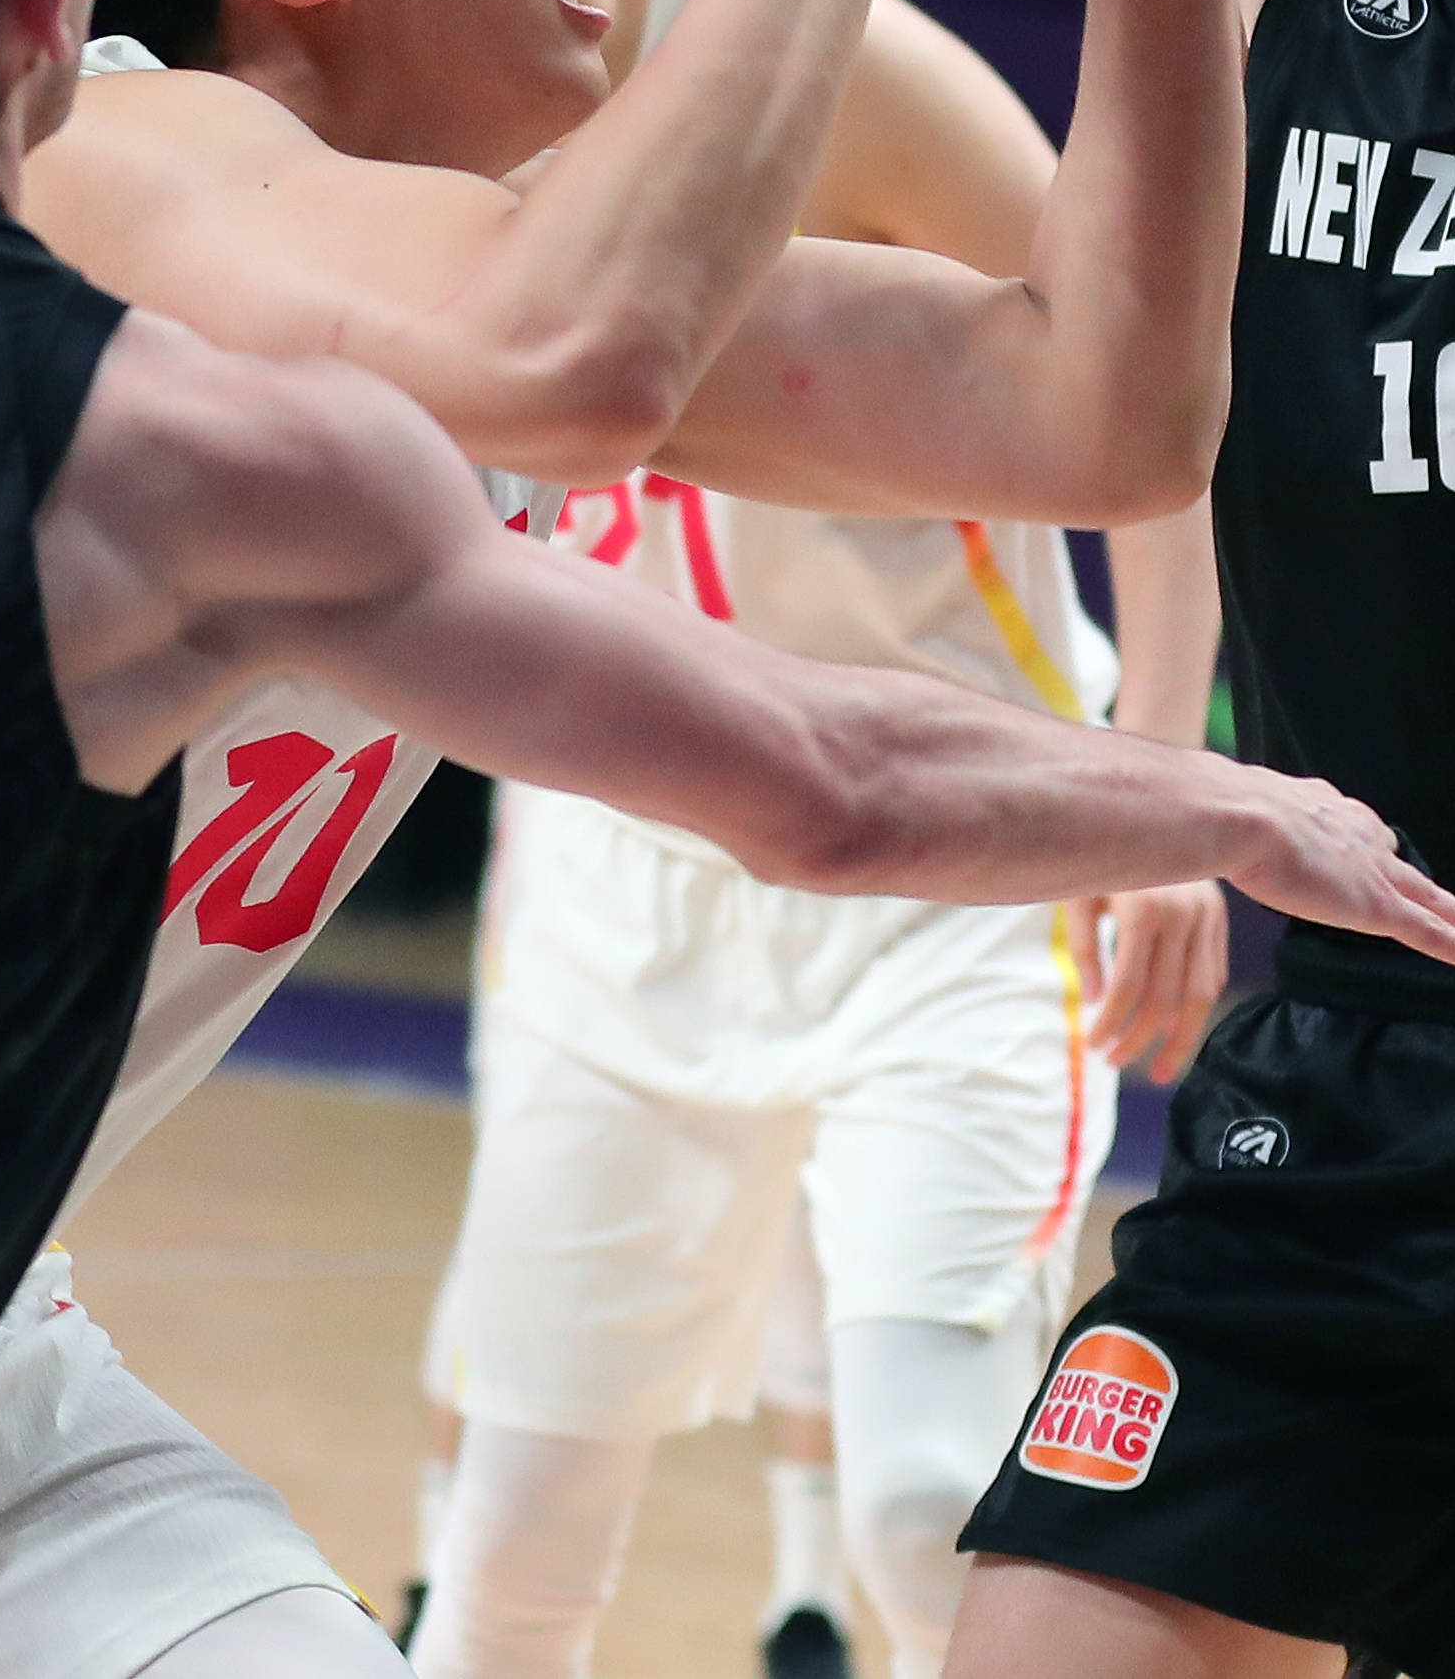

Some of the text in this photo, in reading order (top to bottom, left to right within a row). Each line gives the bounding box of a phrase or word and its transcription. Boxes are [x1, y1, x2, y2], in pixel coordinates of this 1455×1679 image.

[1268, 127, 1392, 271] NEW
[1048, 1374, 1164, 1424] BURGER
[1031, 1402, 1153, 1462] KING
